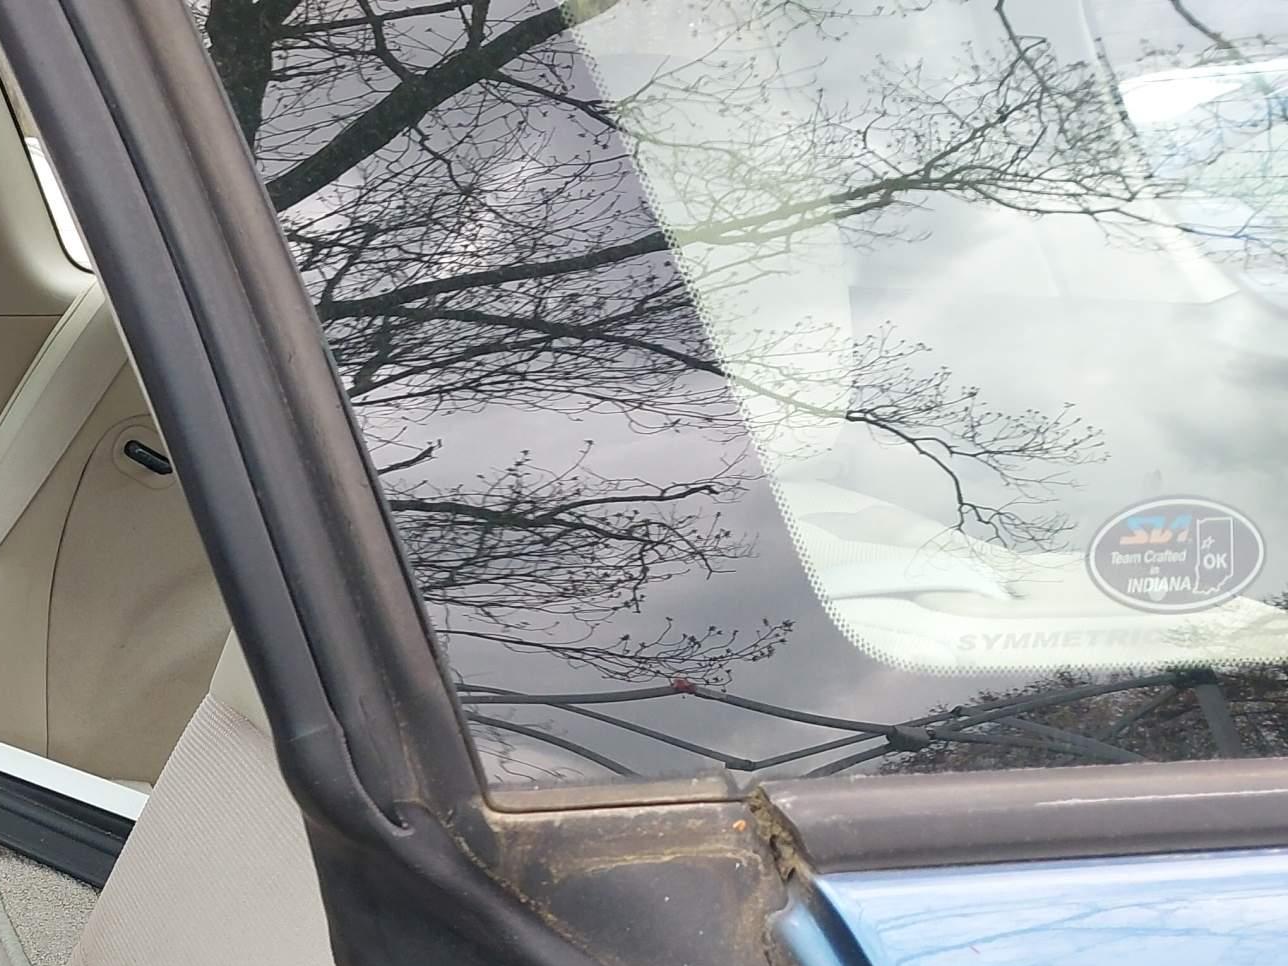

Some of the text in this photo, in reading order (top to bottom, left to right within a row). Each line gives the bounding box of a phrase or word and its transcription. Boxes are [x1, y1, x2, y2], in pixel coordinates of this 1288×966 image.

[1110, 549, 1187, 564] Team Crafted
[1203, 552, 1228, 570] OK
[1149, 566, 1160, 575] in
[1127, 576, 1192, 593] INDIANA
